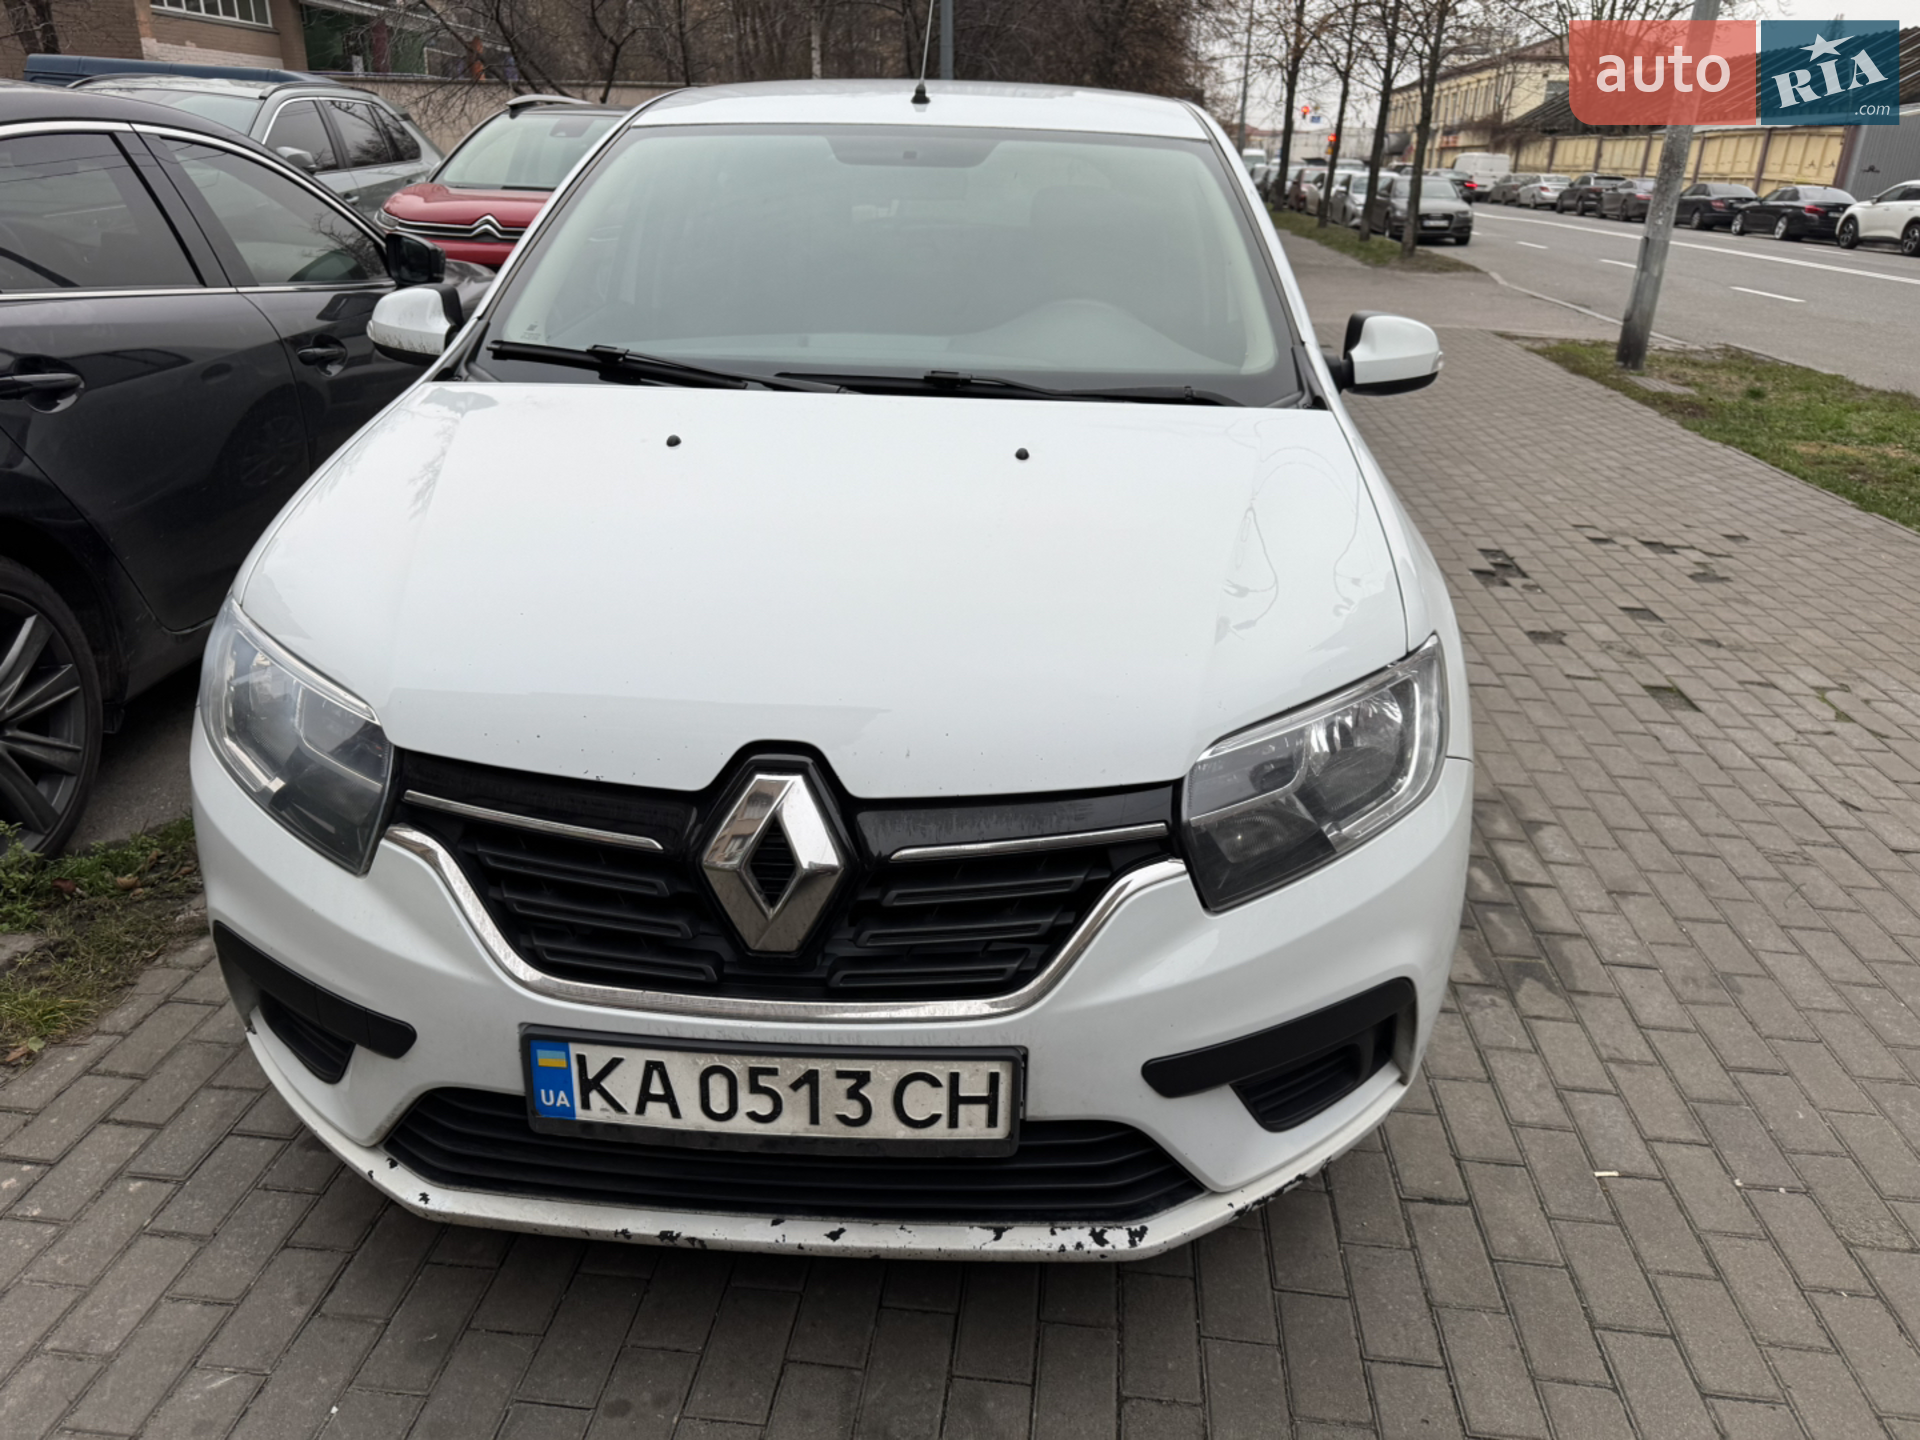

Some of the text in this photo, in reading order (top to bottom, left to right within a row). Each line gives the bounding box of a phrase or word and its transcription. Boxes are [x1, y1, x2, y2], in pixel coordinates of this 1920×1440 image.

[540, 1089, 571, 1107] UA
[575, 1053, 1000, 1129] KA 0513 CH
